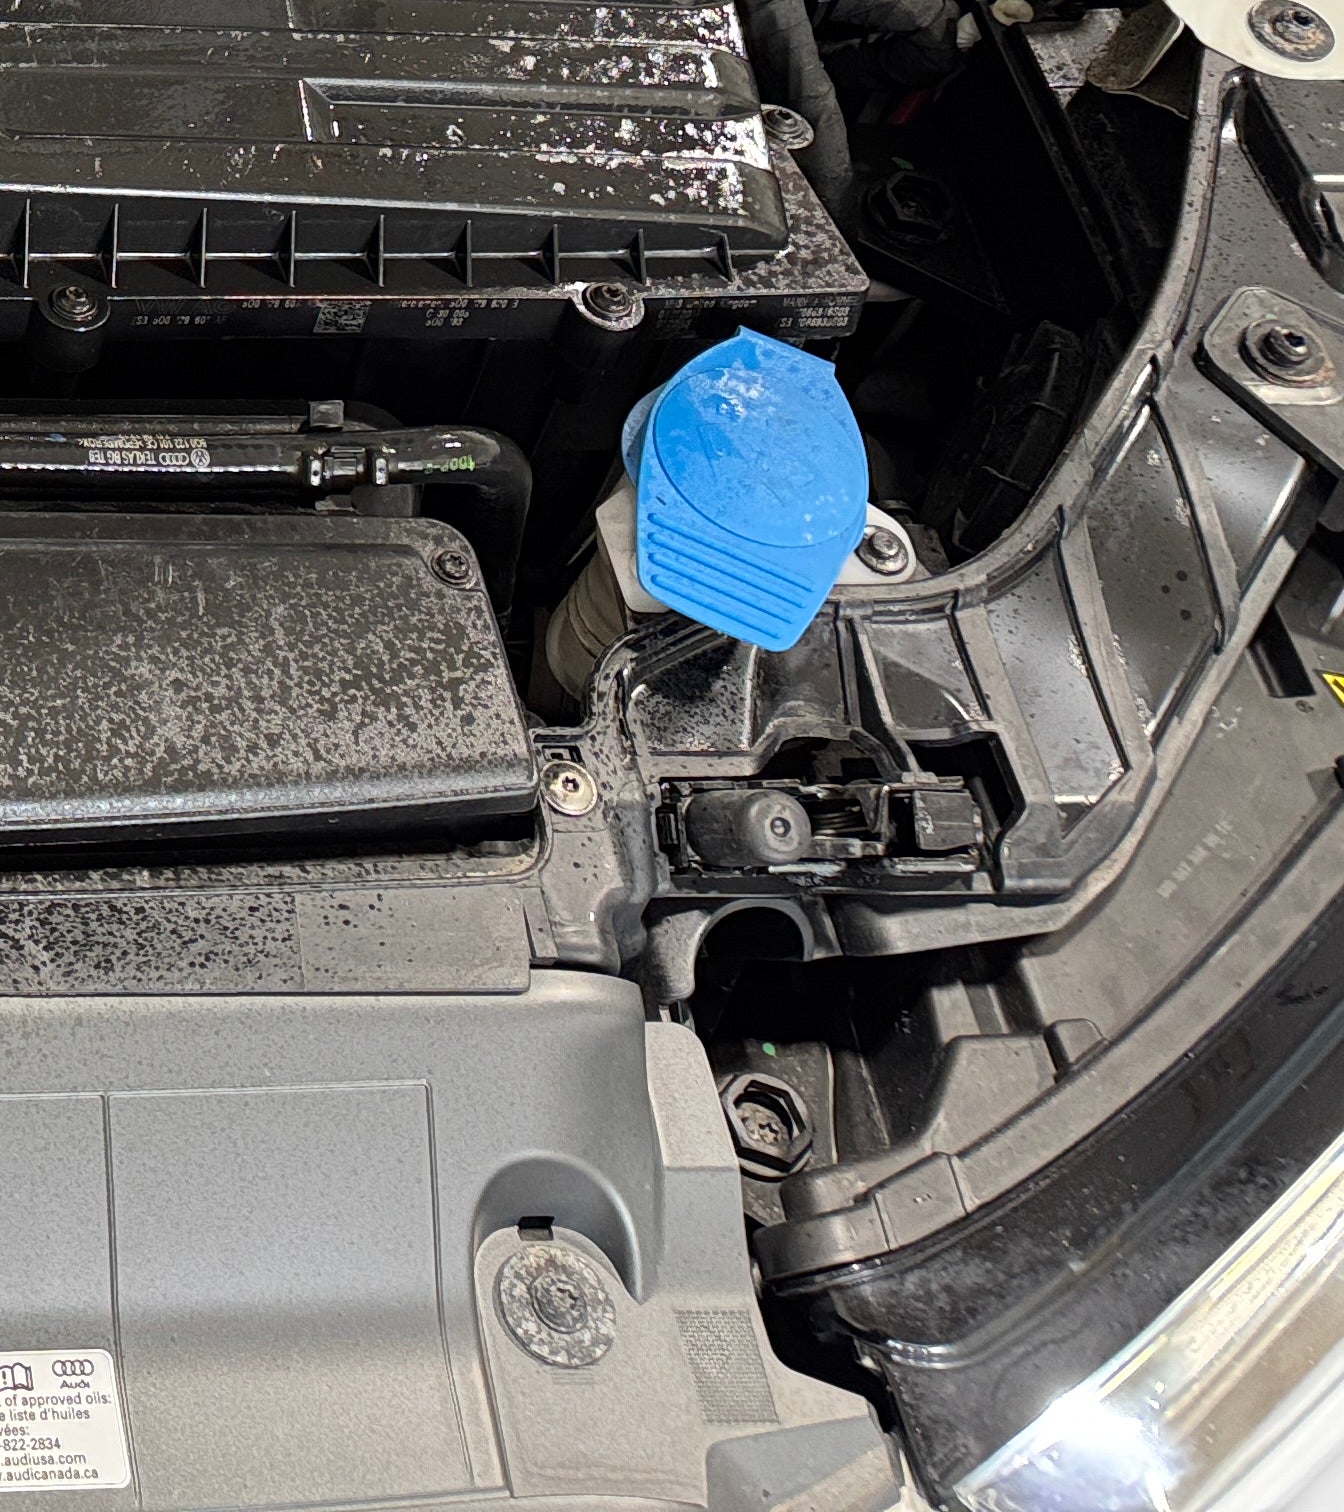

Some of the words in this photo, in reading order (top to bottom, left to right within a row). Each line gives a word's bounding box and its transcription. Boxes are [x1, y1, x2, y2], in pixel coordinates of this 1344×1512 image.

[122, 450, 157, 465] TEKLAS
[60, 1379, 91, 1389] Audi
[5, 1394, 18, 1407] of
[21, 1392, 82, 1409] approved
[86, 1391, 112, 1404] oils:
[9, 1409, 36, 1421] liste
[40, 1407, 90, 1421] d'huiles
